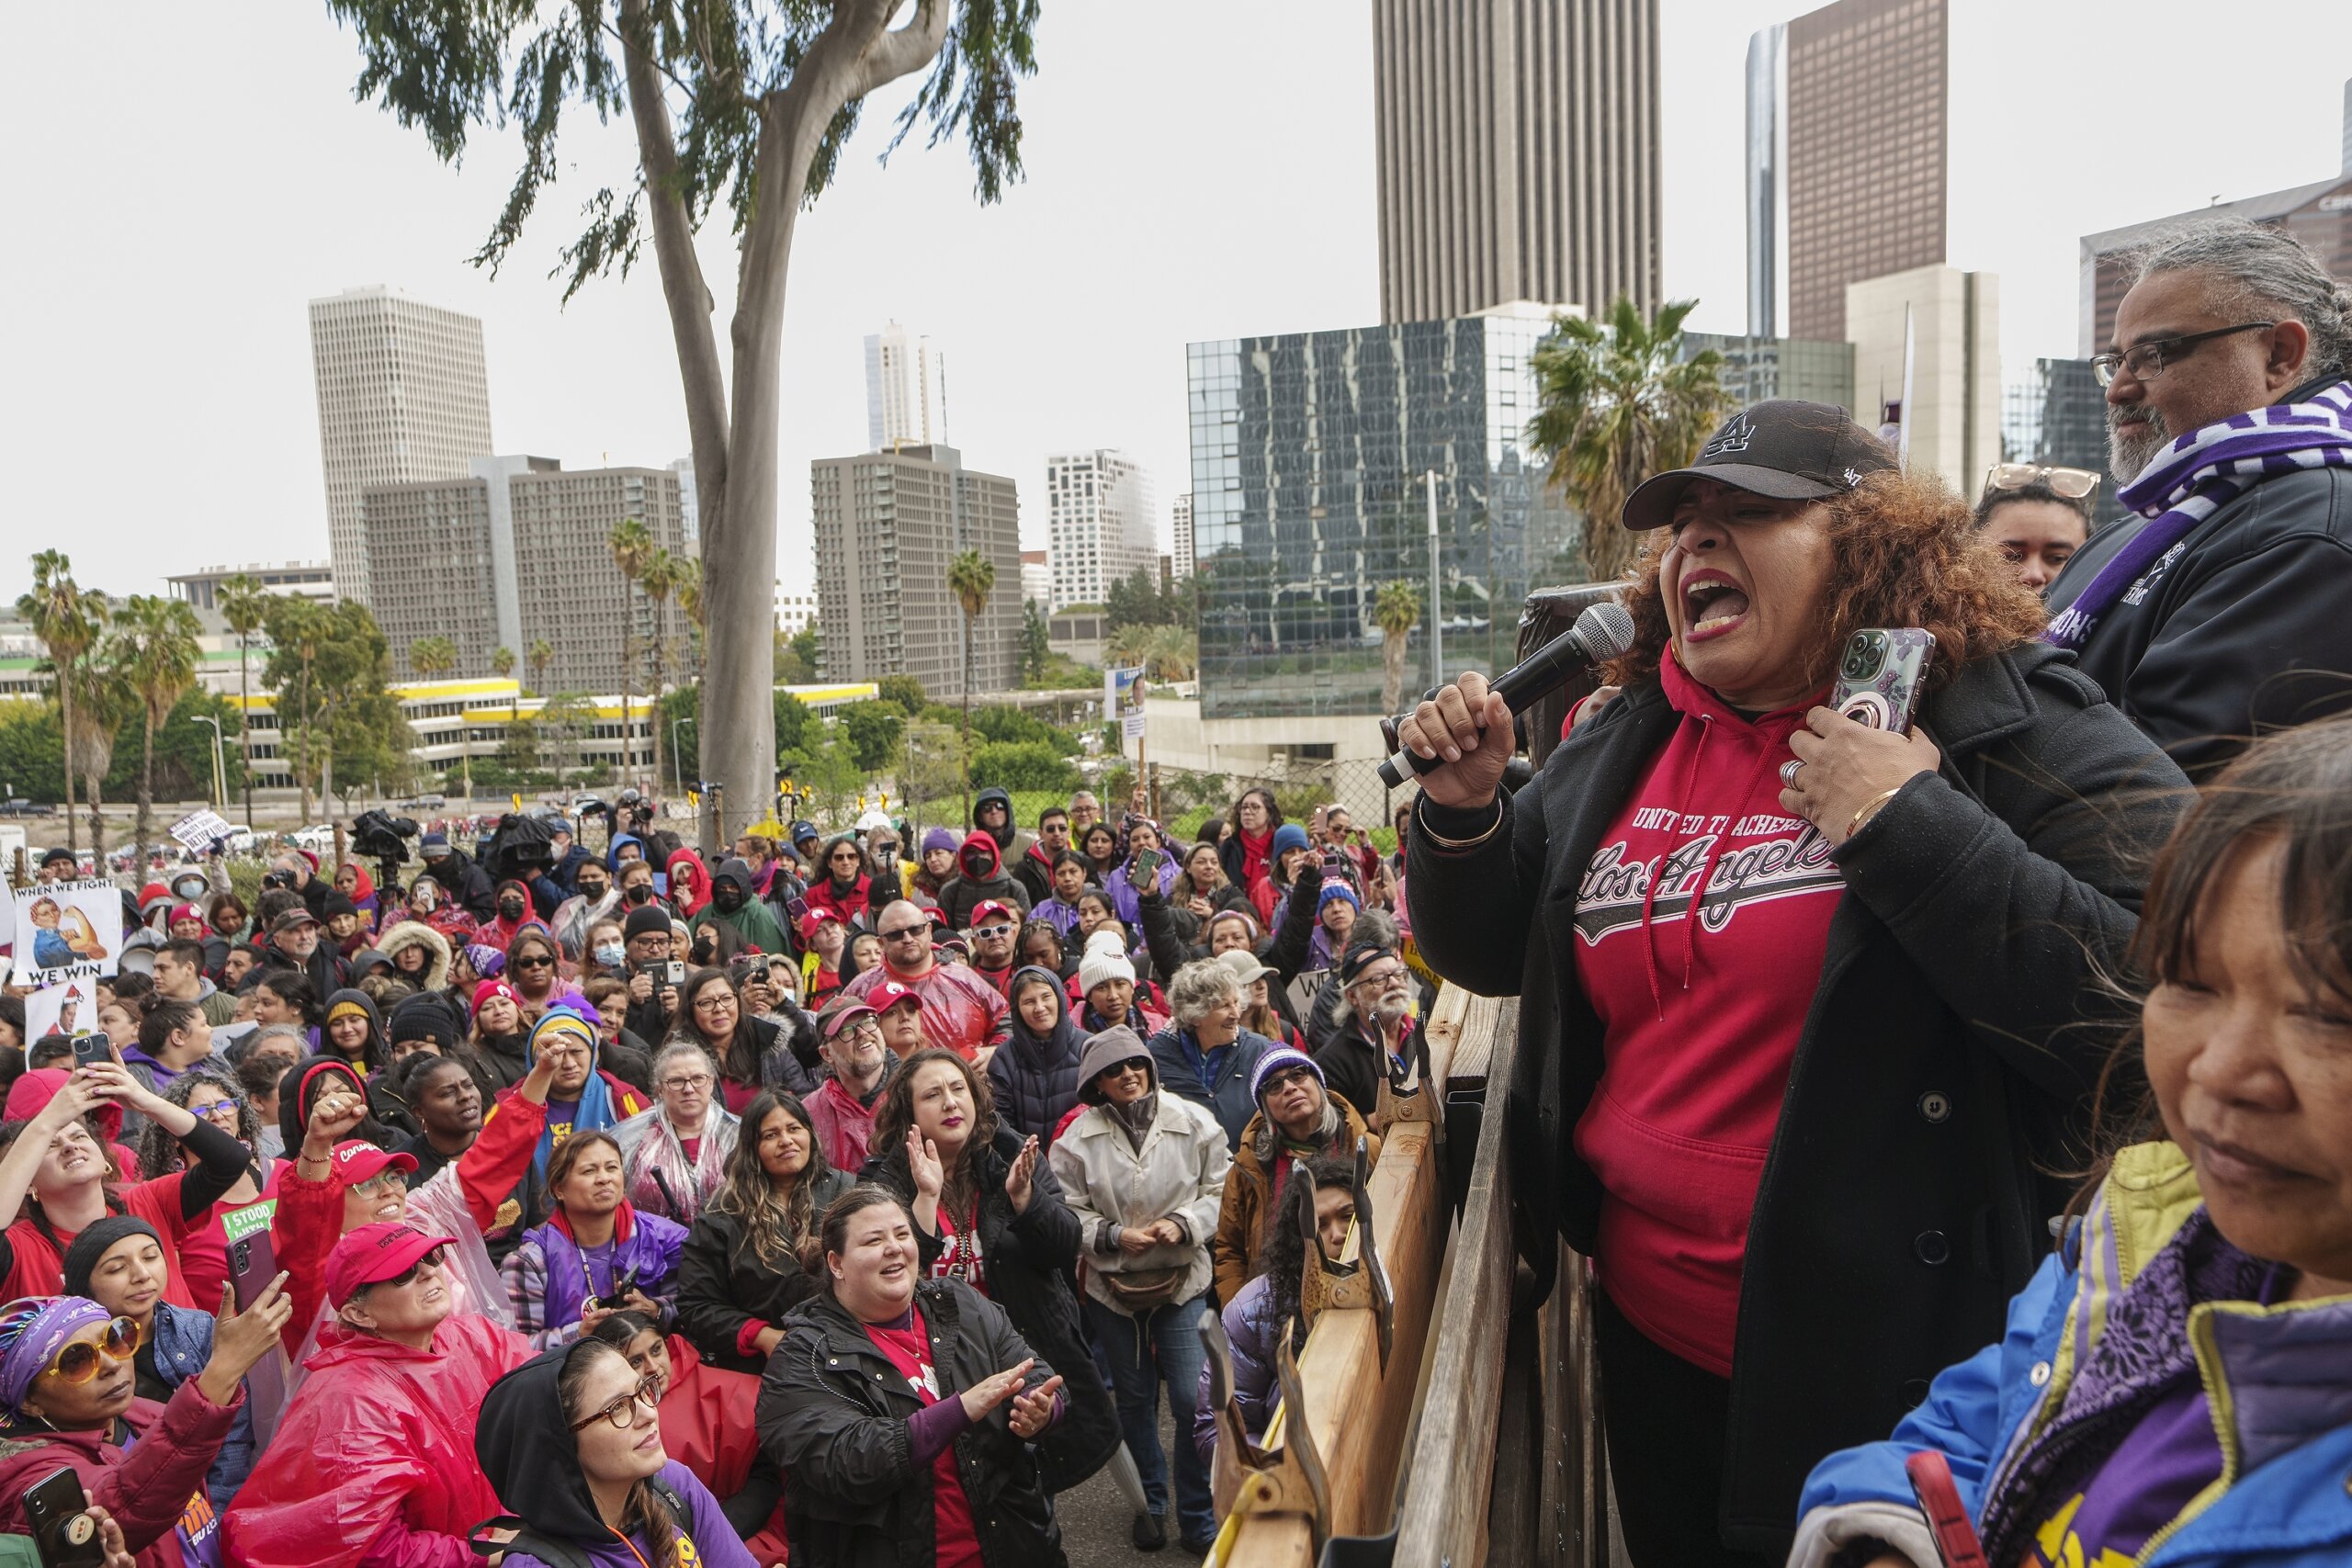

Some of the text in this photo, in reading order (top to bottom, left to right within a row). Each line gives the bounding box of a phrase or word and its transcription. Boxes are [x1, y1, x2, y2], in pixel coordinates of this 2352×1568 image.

[1632, 807, 1705, 835] UNITED
[17, 879, 114, 897] WHEN WE FIGHT
[1576, 827, 1834, 933] Los Angele
[28, 964, 101, 984] WE WIN
[224, 1204, 270, 1230] I STOOD
[187, 1528, 206, 1546] EIU
